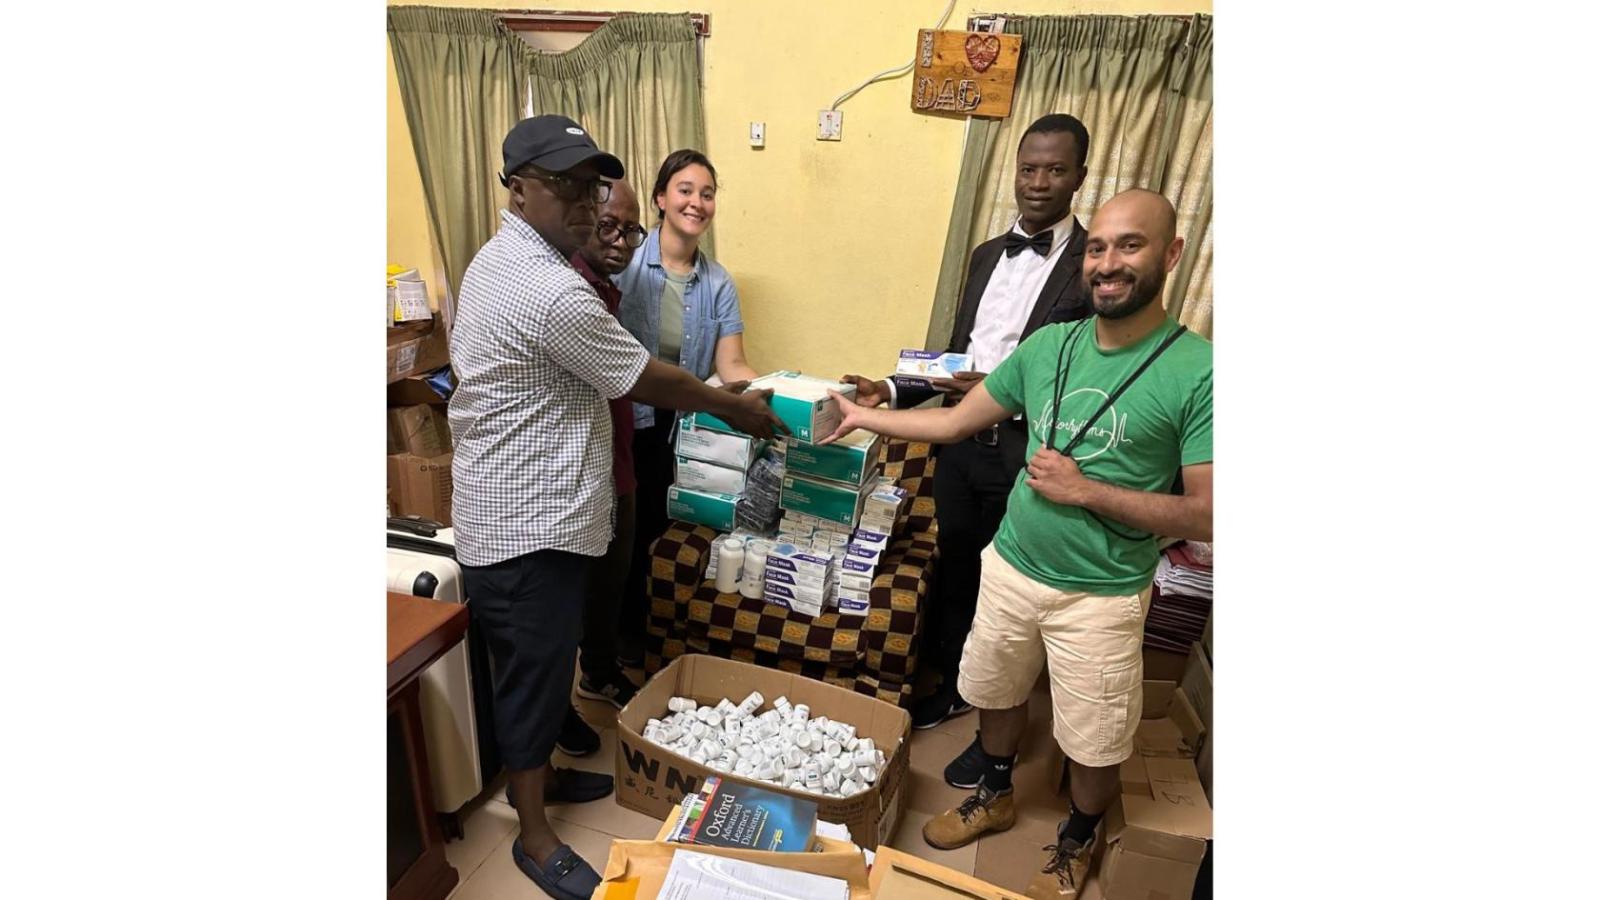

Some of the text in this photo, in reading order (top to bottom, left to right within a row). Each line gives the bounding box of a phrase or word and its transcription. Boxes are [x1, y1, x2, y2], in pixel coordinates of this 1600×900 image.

[916, 77, 981, 112] DAD
[801, 429, 808, 438] M
[705, 793, 736, 837] Oxford
[721, 803, 743, 841] Advanced
[730, 809, 752, 843] Learner's
[740, 804, 765, 846] Dictionary
